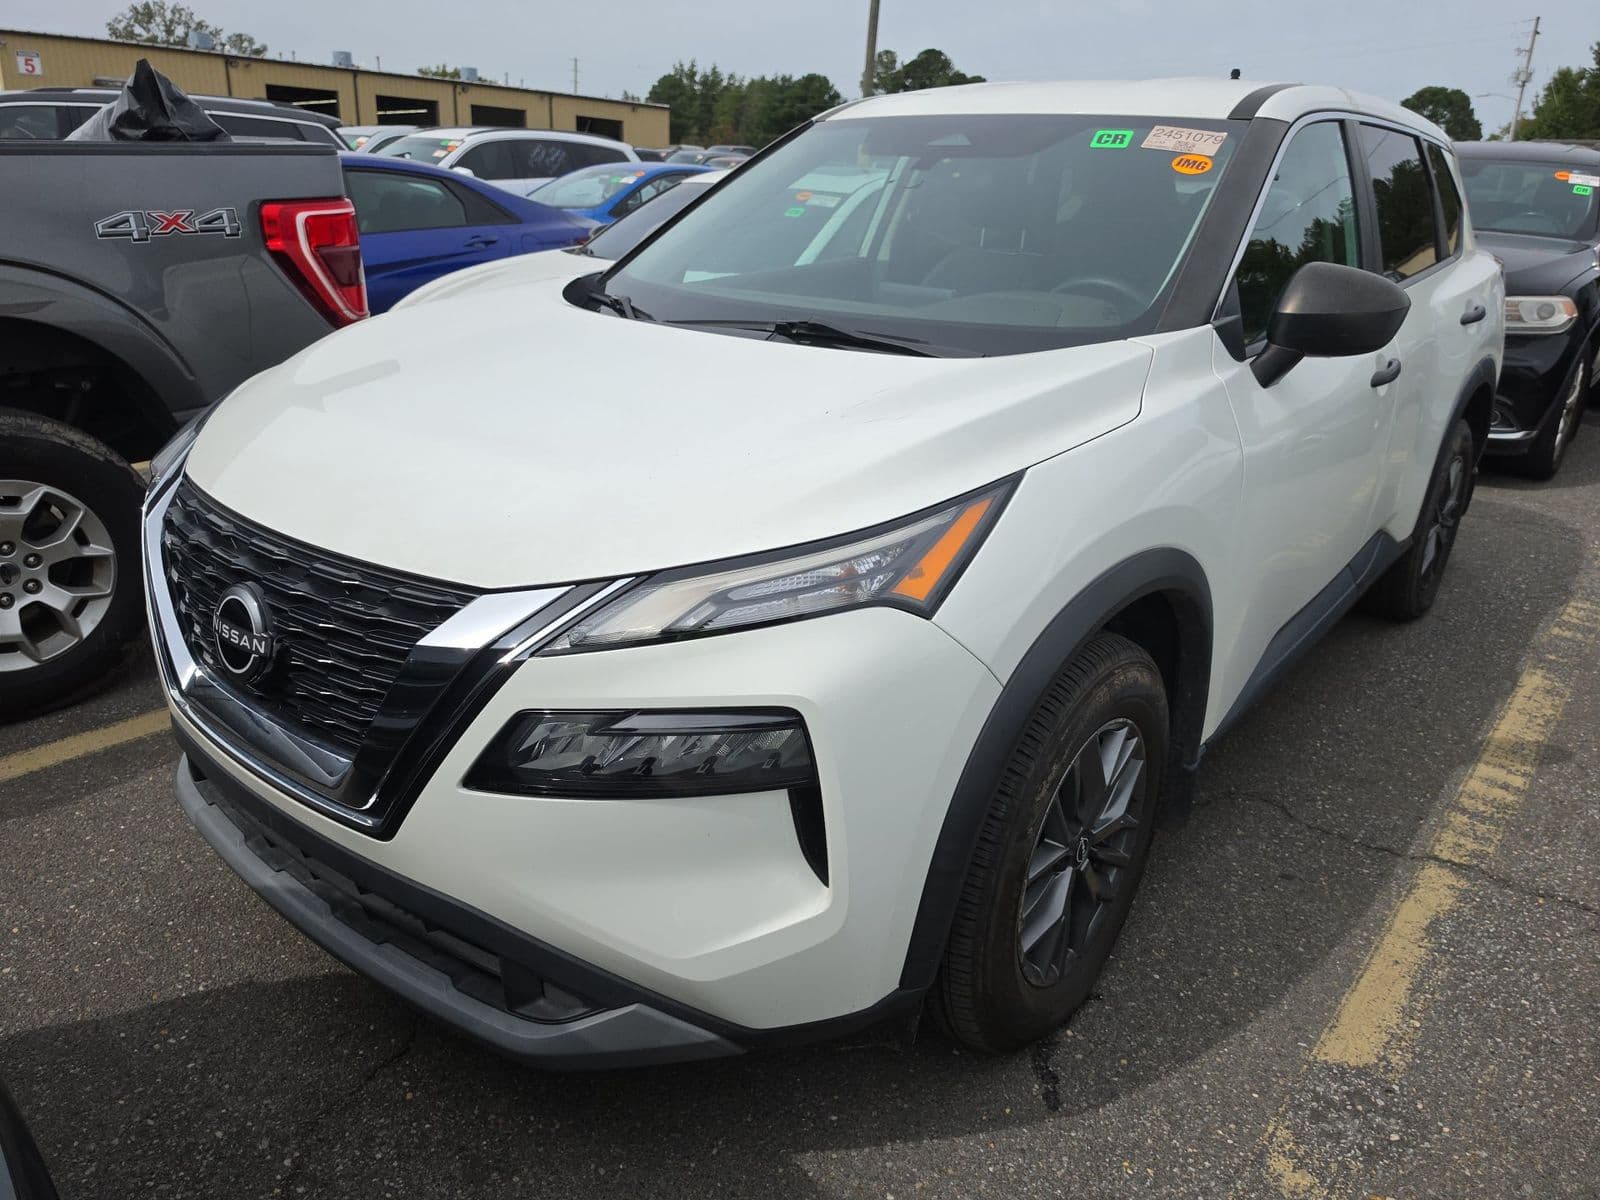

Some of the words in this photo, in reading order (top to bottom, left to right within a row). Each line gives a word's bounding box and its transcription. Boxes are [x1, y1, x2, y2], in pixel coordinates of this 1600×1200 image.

[24, 58, 36, 74] 5
[1095, 133, 1127, 145] CR
[1152, 128, 1224, 145] 2451079
[1175, 157, 1208, 171] IMG
[213, 616, 266, 654] NISSAN
